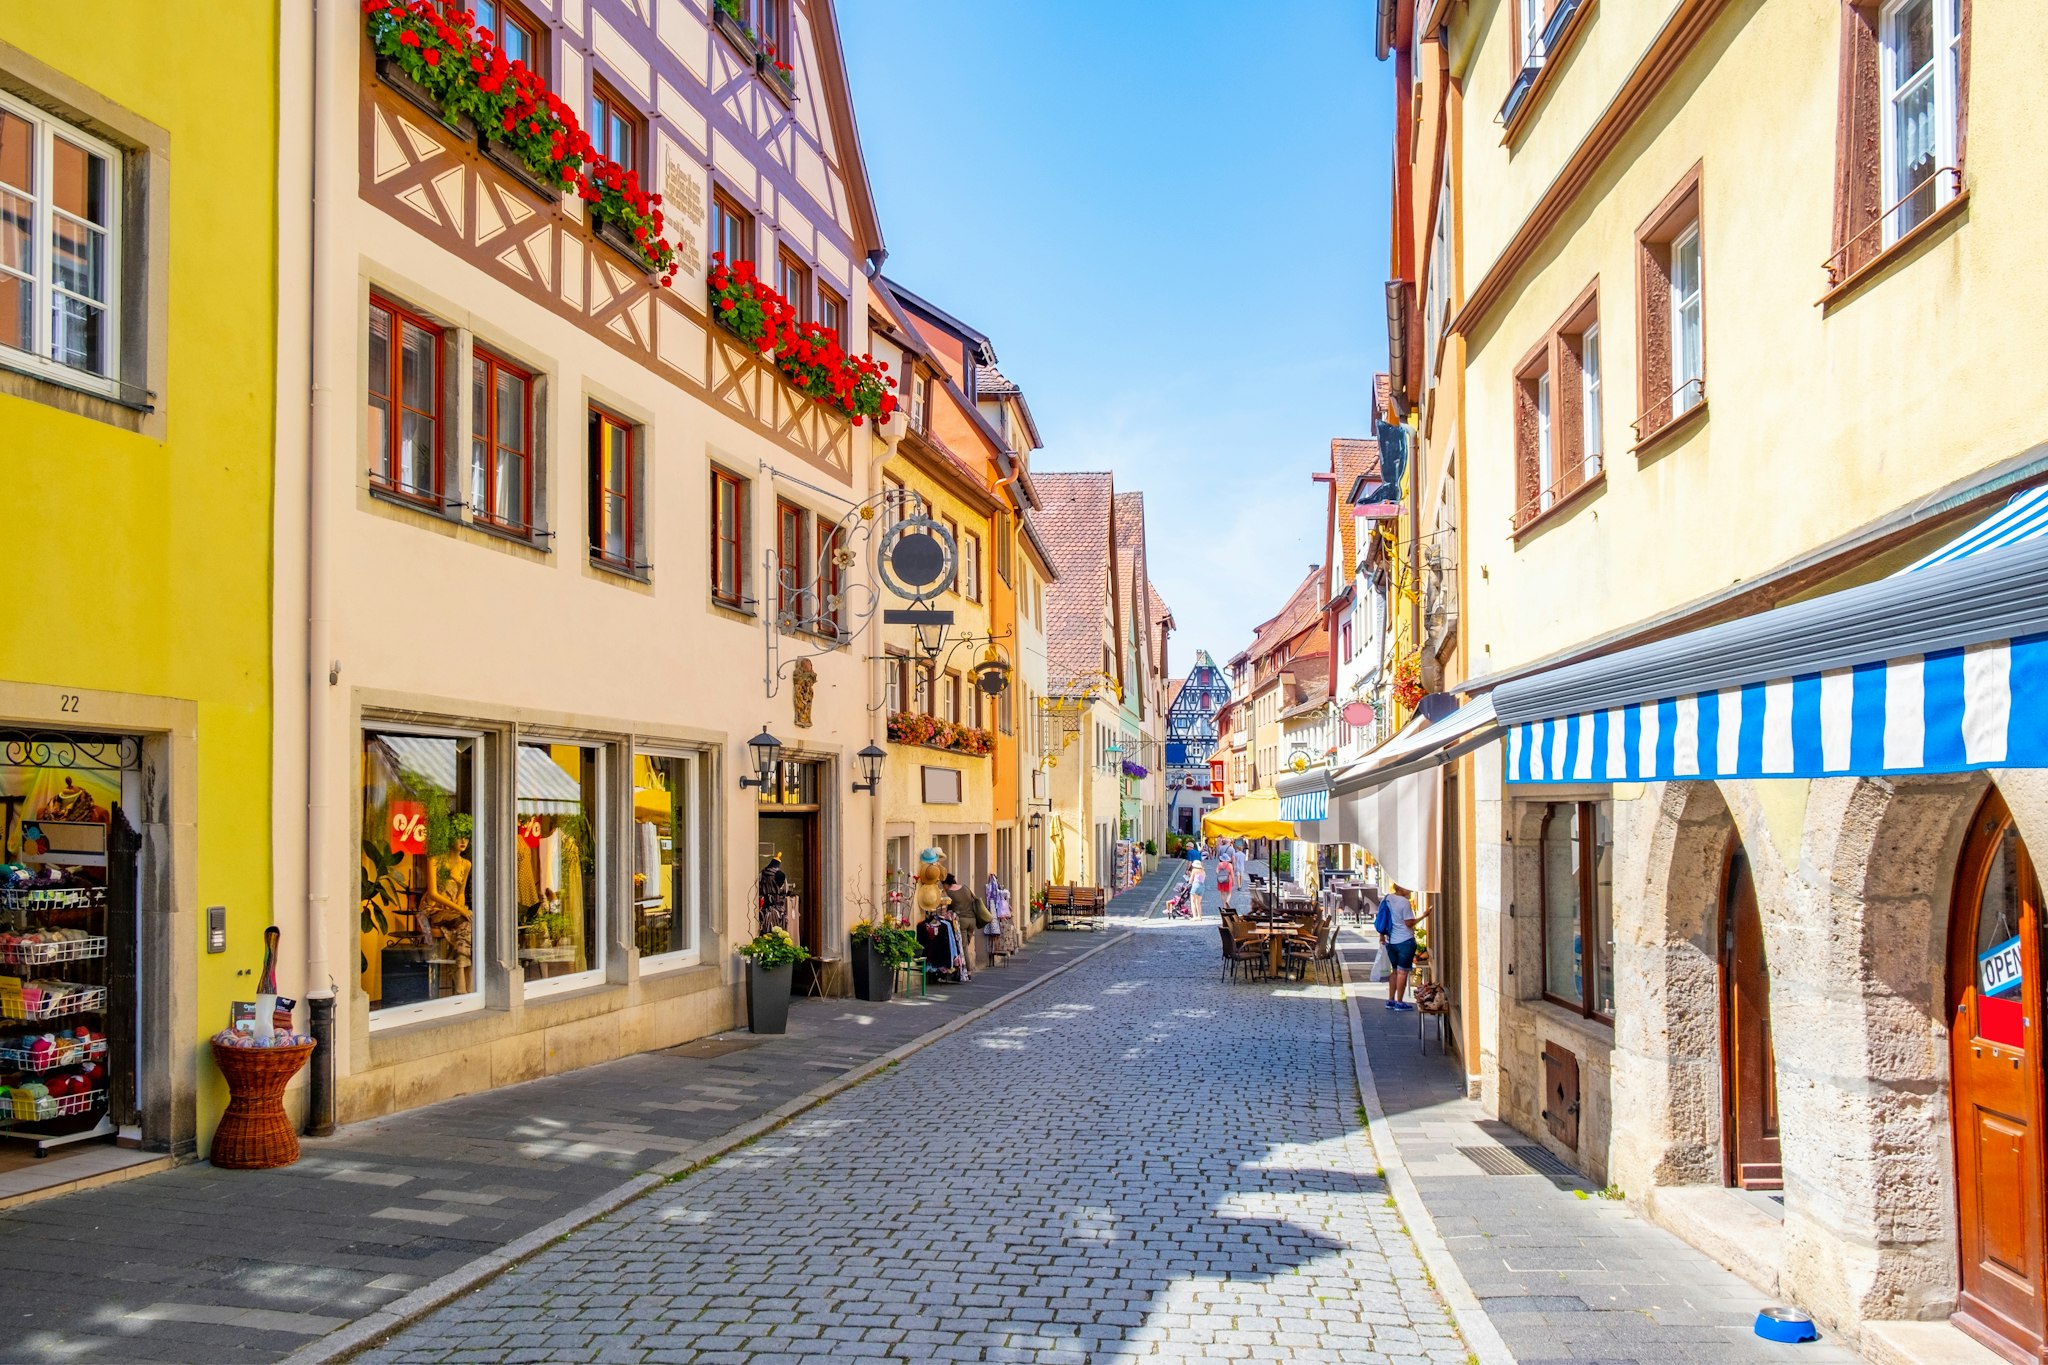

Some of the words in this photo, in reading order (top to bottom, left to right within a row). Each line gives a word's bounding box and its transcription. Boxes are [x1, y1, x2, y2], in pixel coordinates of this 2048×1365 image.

[61, 694, 79, 713] 22
[393, 813, 427, 842] %
[1985, 944, 2021, 987] OPEN
